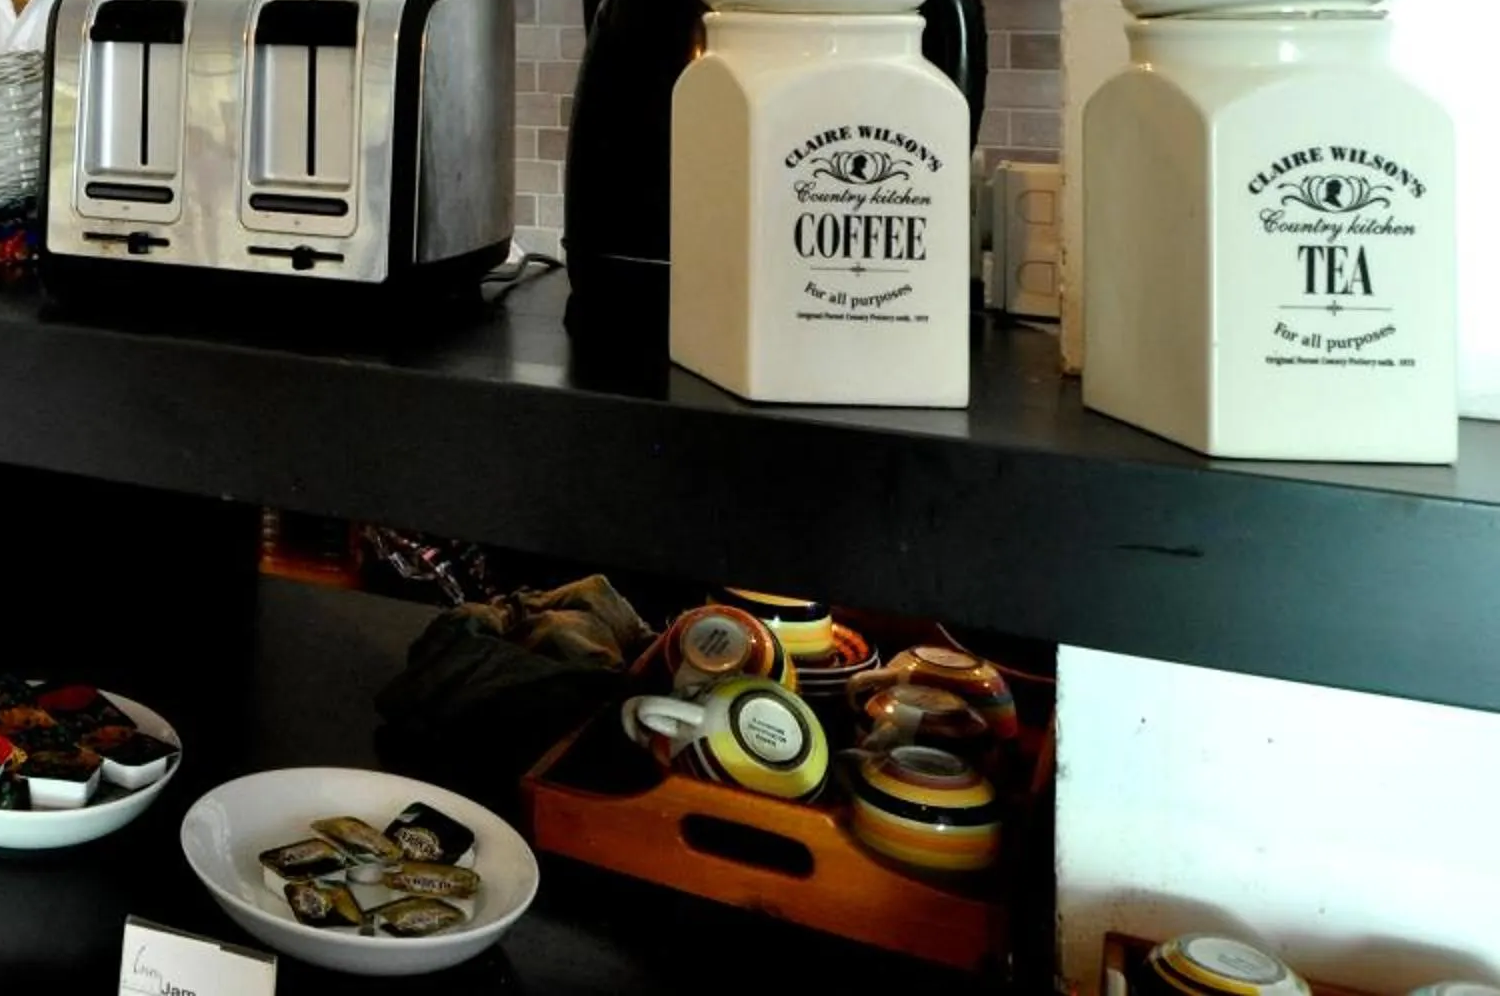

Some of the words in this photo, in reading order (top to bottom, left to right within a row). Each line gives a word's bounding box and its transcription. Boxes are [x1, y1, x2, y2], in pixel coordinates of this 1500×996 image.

[785, 126, 852, 169] CLAIRE
[858, 125, 943, 172] WILSON'S
[1248, 147, 1323, 195] CLAIRE
[1329, 145, 1427, 199] WILSON'S
[794, 180, 866, 211] Country
[870, 186, 931, 205] kitchen
[794, 212, 927, 261] COFFEE
[1259, 208, 1344, 242] Country
[1347, 215, 1415, 235] kitchen
[1297, 245, 1374, 296] TEA
[804, 281, 826, 300] For
[828, 291, 846, 305] all
[851, 284, 913, 310] purposes
[1274, 322, 1299, 341] For
[1301, 333, 1321, 348] all
[1326, 324, 1397, 352] purposes
[161, 982, 197, 996] Jam
